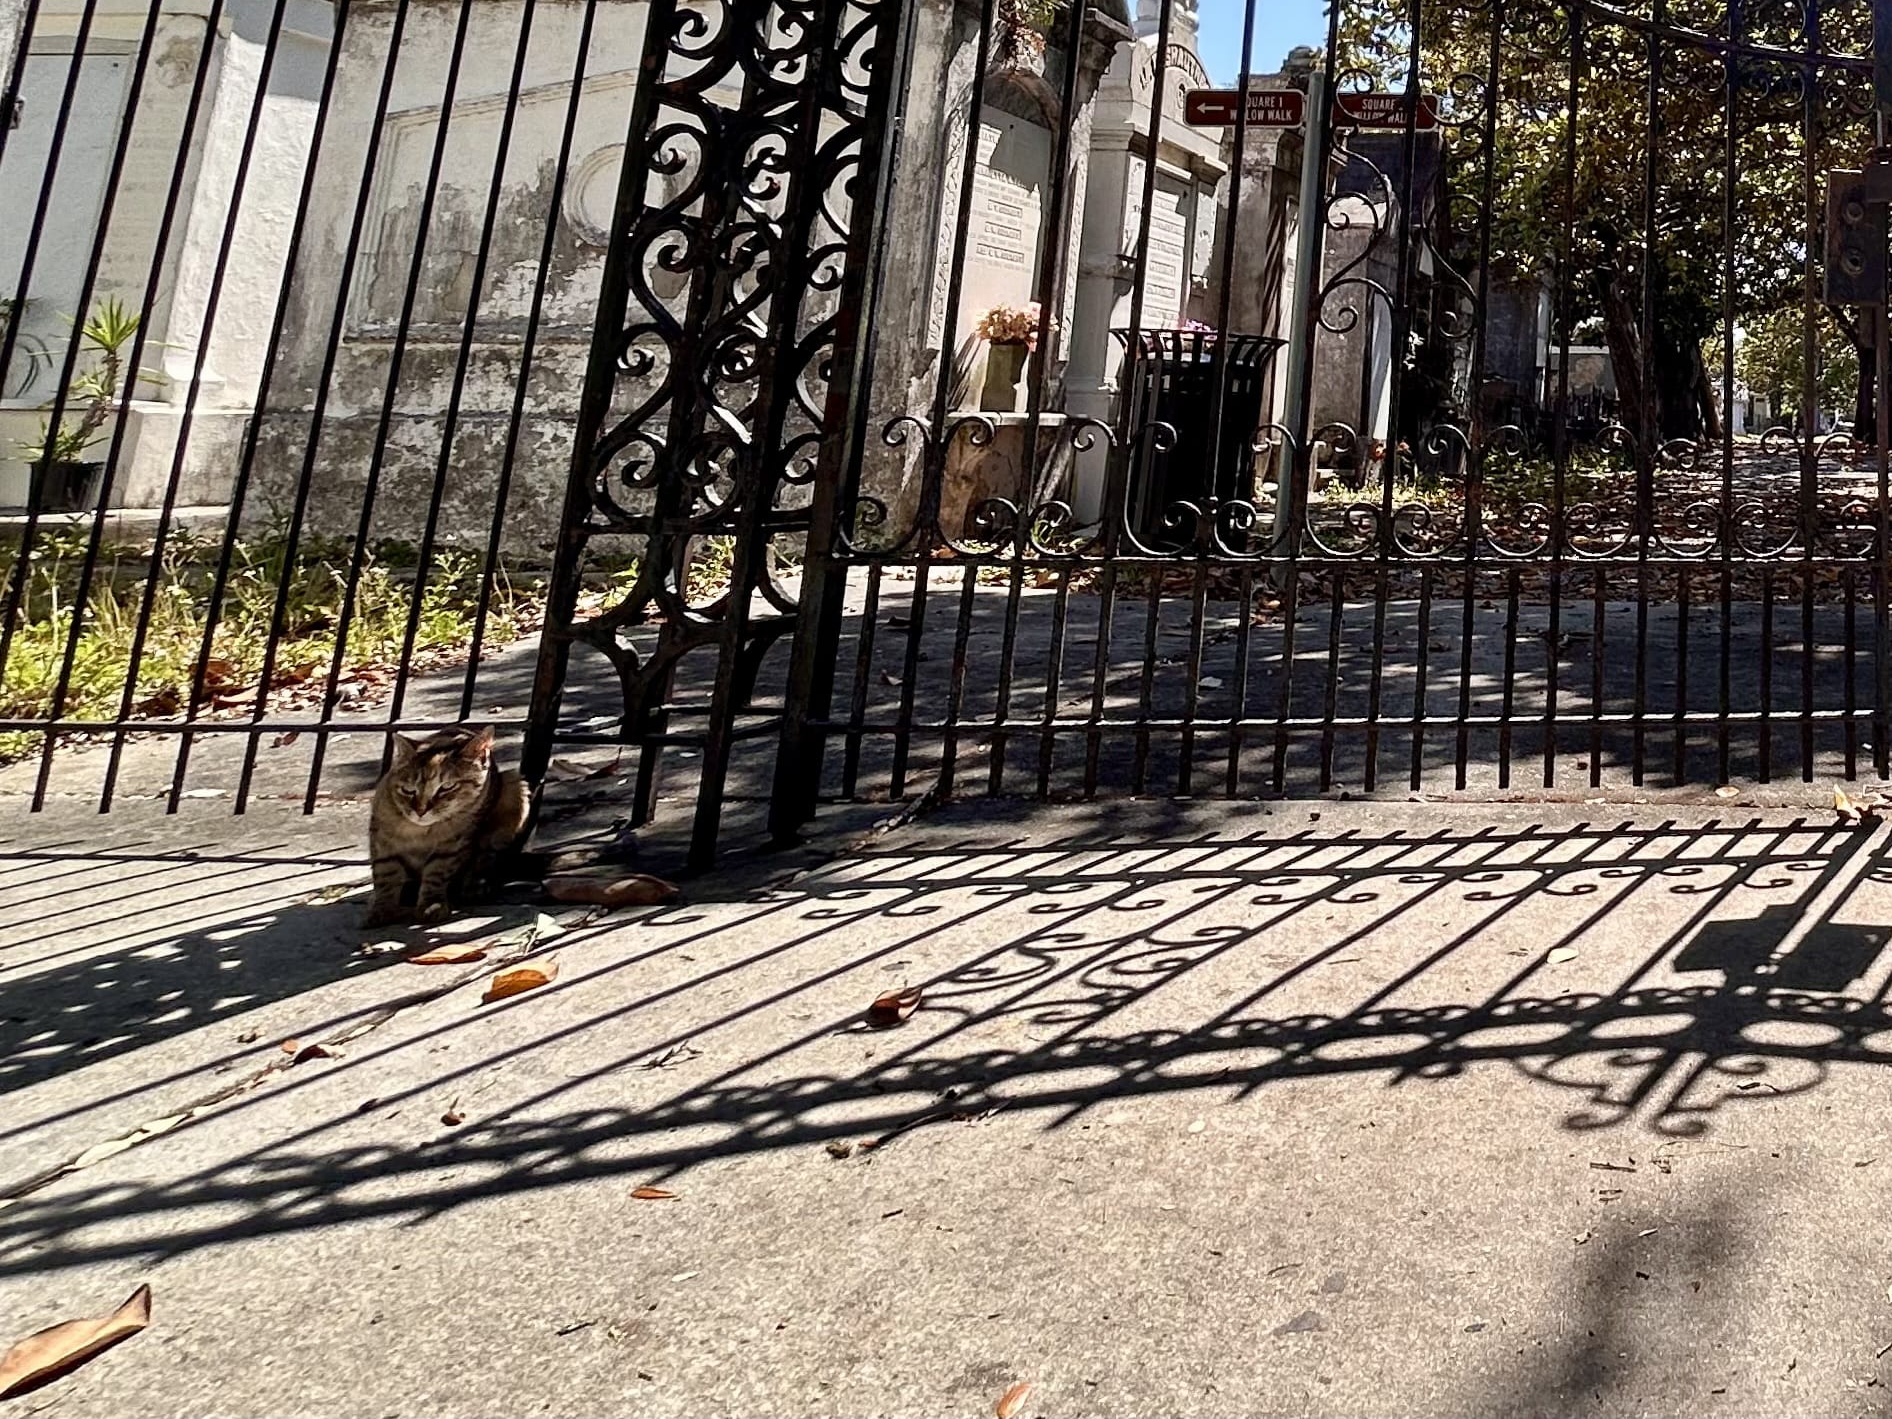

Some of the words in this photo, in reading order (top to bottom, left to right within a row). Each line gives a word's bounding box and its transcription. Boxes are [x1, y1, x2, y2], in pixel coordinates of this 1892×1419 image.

[1246, 96, 1276, 108] QUARE
[1229, 109, 1265, 122] WLOW
[1267, 109, 1293, 122] WALK
